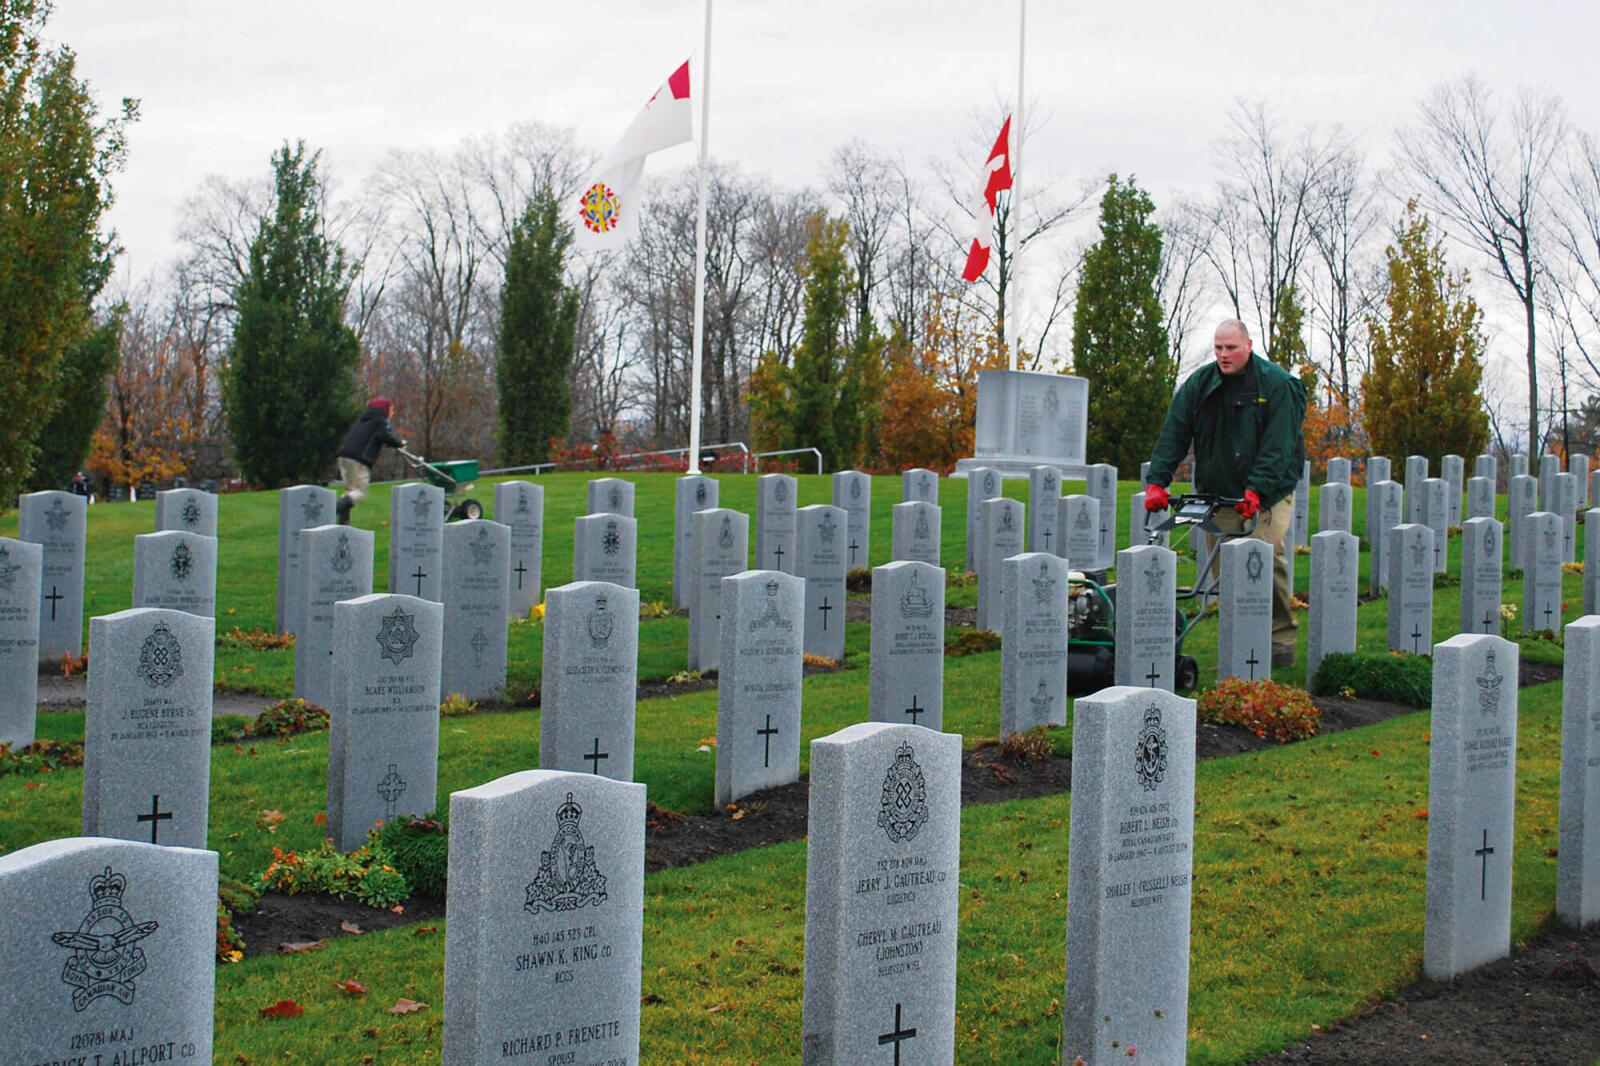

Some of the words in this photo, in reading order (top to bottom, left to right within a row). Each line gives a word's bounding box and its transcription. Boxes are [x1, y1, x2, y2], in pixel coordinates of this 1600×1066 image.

[130, 708, 159, 720] EUGENE
[1120, 819, 1142, 834] ROBERT
[856, 877, 881, 894] JERRY
[893, 870, 935, 888] GAUTREAU
[937, 871, 947, 882] CD
[583, 926, 597, 940] CPL
[857, 928, 888, 947] CHERYL
[901, 920, 942, 940] GAUTREAU
[515, 952, 554, 972] SHAWN
[558, 948, 569, 965] K.
[573, 944, 598, 963] KING
[601, 945, 612, 958] CD
[876, 939, 923, 963] (JOHNSTON)
[71, 1031, 105, 1050] 120781
[109, 1027, 135, 1044] MAJ
[502, 1033, 552, 1058] RICHARD
[555, 1031, 565, 1048] P.
[568, 1020, 620, 1045] FRENETTE
[112, 1042, 176, 1066] ALLPORT
[181, 1043, 196, 1058] CD
[547, 1051, 576, 1066] SPOUSE
